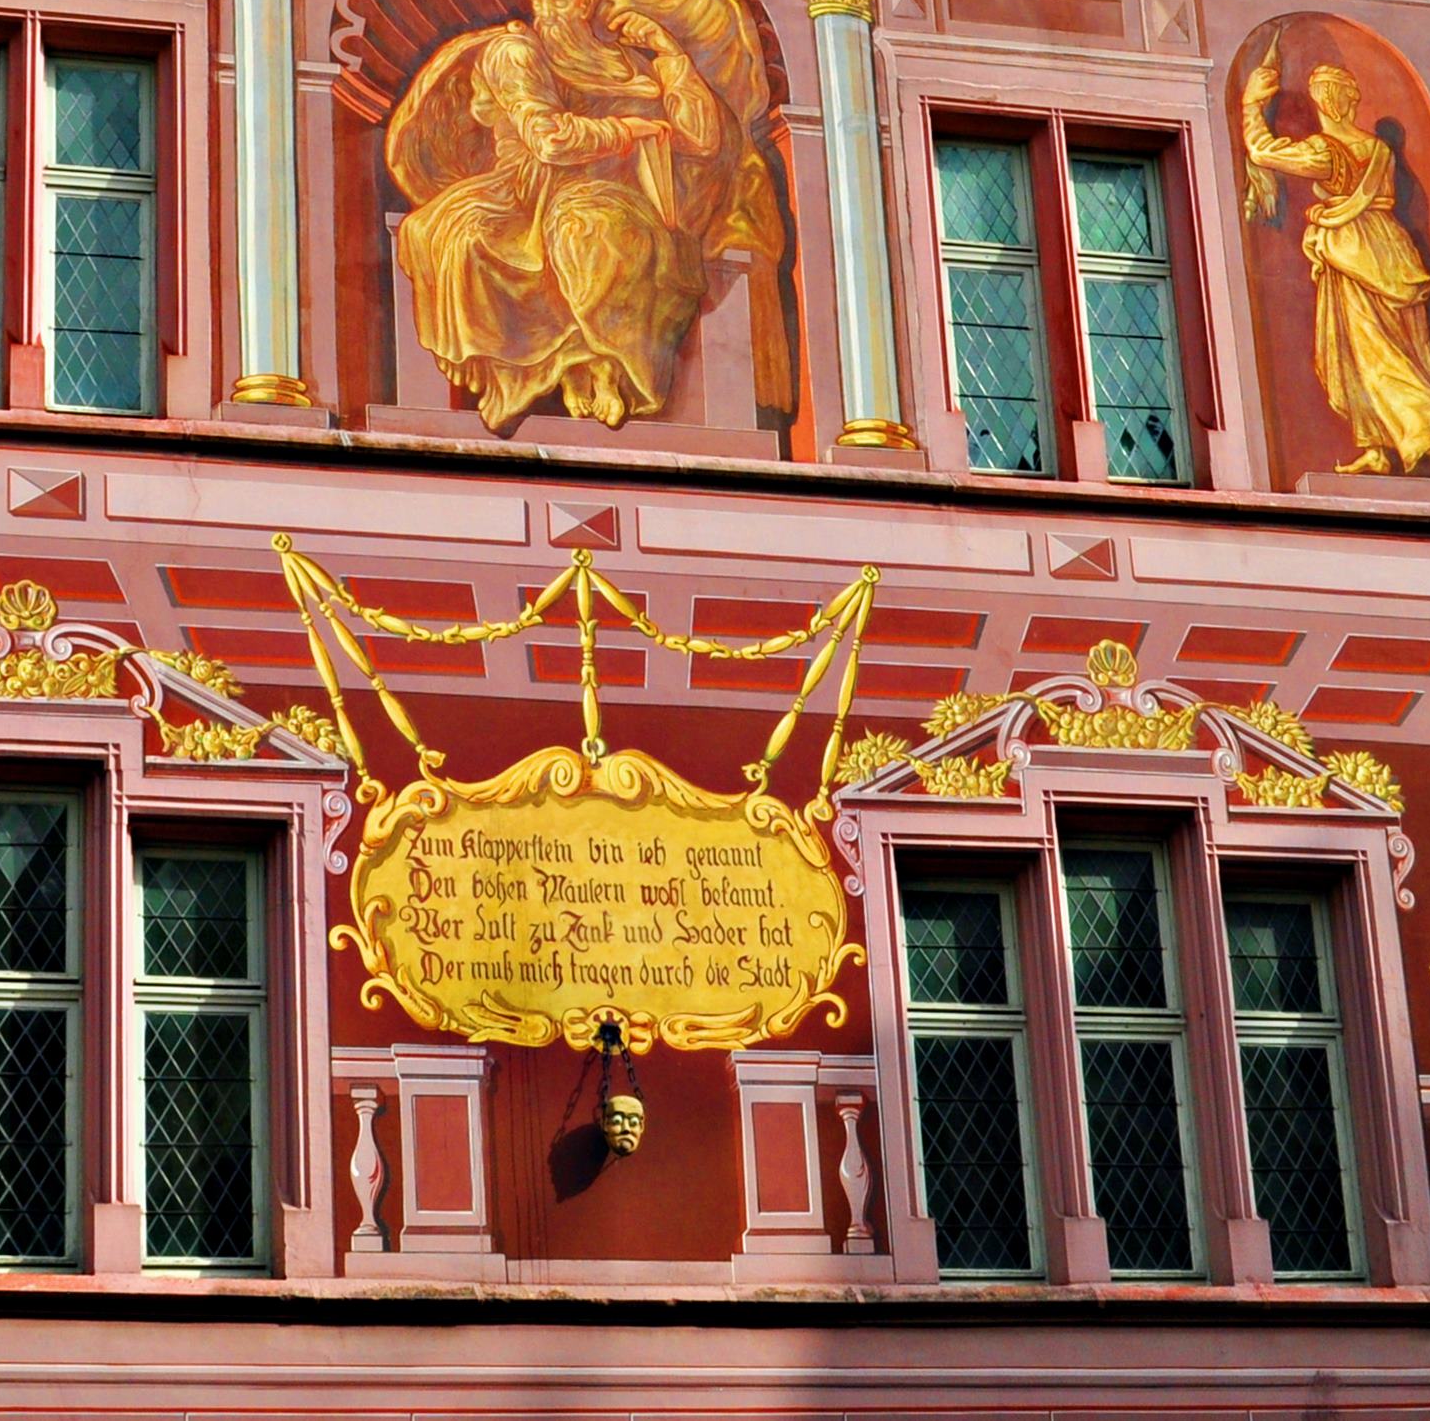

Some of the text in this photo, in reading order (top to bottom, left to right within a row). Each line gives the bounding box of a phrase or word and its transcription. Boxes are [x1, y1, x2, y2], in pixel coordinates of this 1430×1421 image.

[404, 818, 454, 868] Zum
[589, 837, 624, 865] bin
[686, 842, 763, 880] genannt
[407, 868, 457, 903] Den
[641, 877, 686, 908] wohl
[399, 905, 464, 945] Wer
[529, 921, 557, 955] zu
[623, 912, 663, 944] und
[759, 914, 793, 948] hat
[419, 947, 464, 985] Der
[519, 950, 563, 991] mich
[570, 952, 632, 999] tragen
[639, 955, 694, 988] durch
[706, 955, 730, 986] die
[737, 955, 792, 992] Stadt
